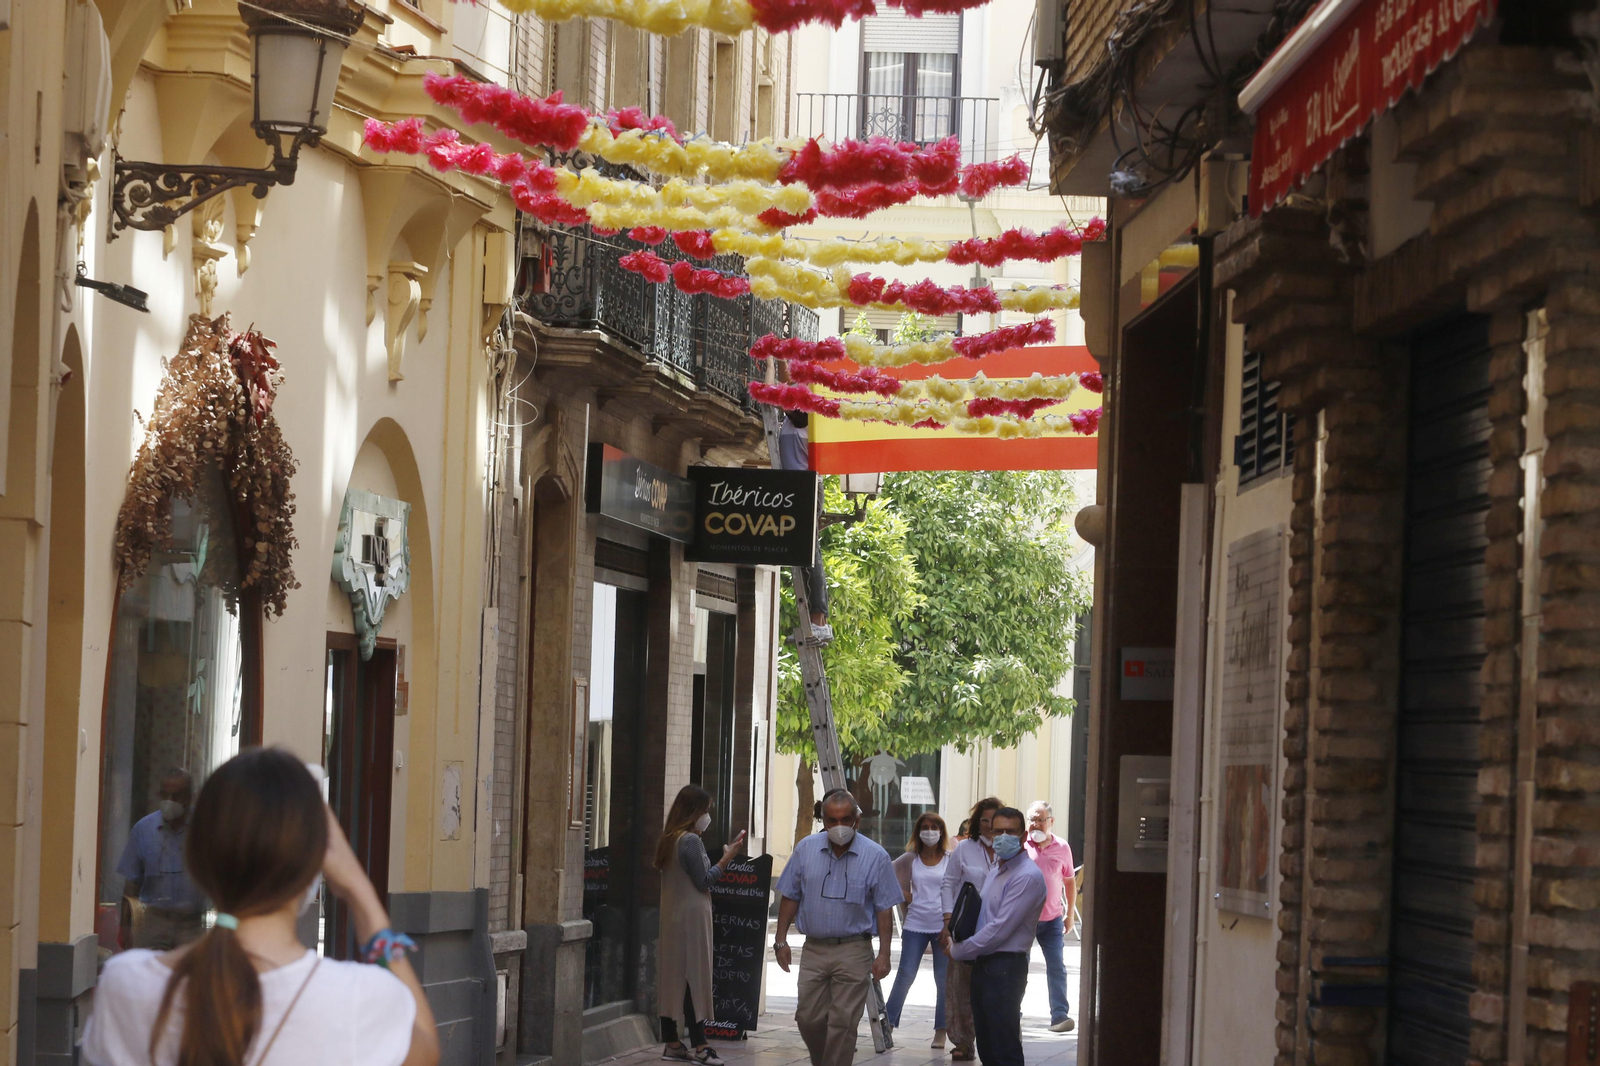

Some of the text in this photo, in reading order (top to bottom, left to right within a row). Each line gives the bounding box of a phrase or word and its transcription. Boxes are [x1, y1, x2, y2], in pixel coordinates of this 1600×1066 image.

[707, 480, 795, 508] Ibéricos
[704, 512, 796, 537] COVAP
[709, 544, 751, 552] MOMENTOS
[713, 914, 761, 930] IERNAS
[722, 926, 731, 937] Y
[713, 944, 754, 958] LETAS
[715, 956, 733, 967] DE
[703, 1027, 738, 1037] OVAP
